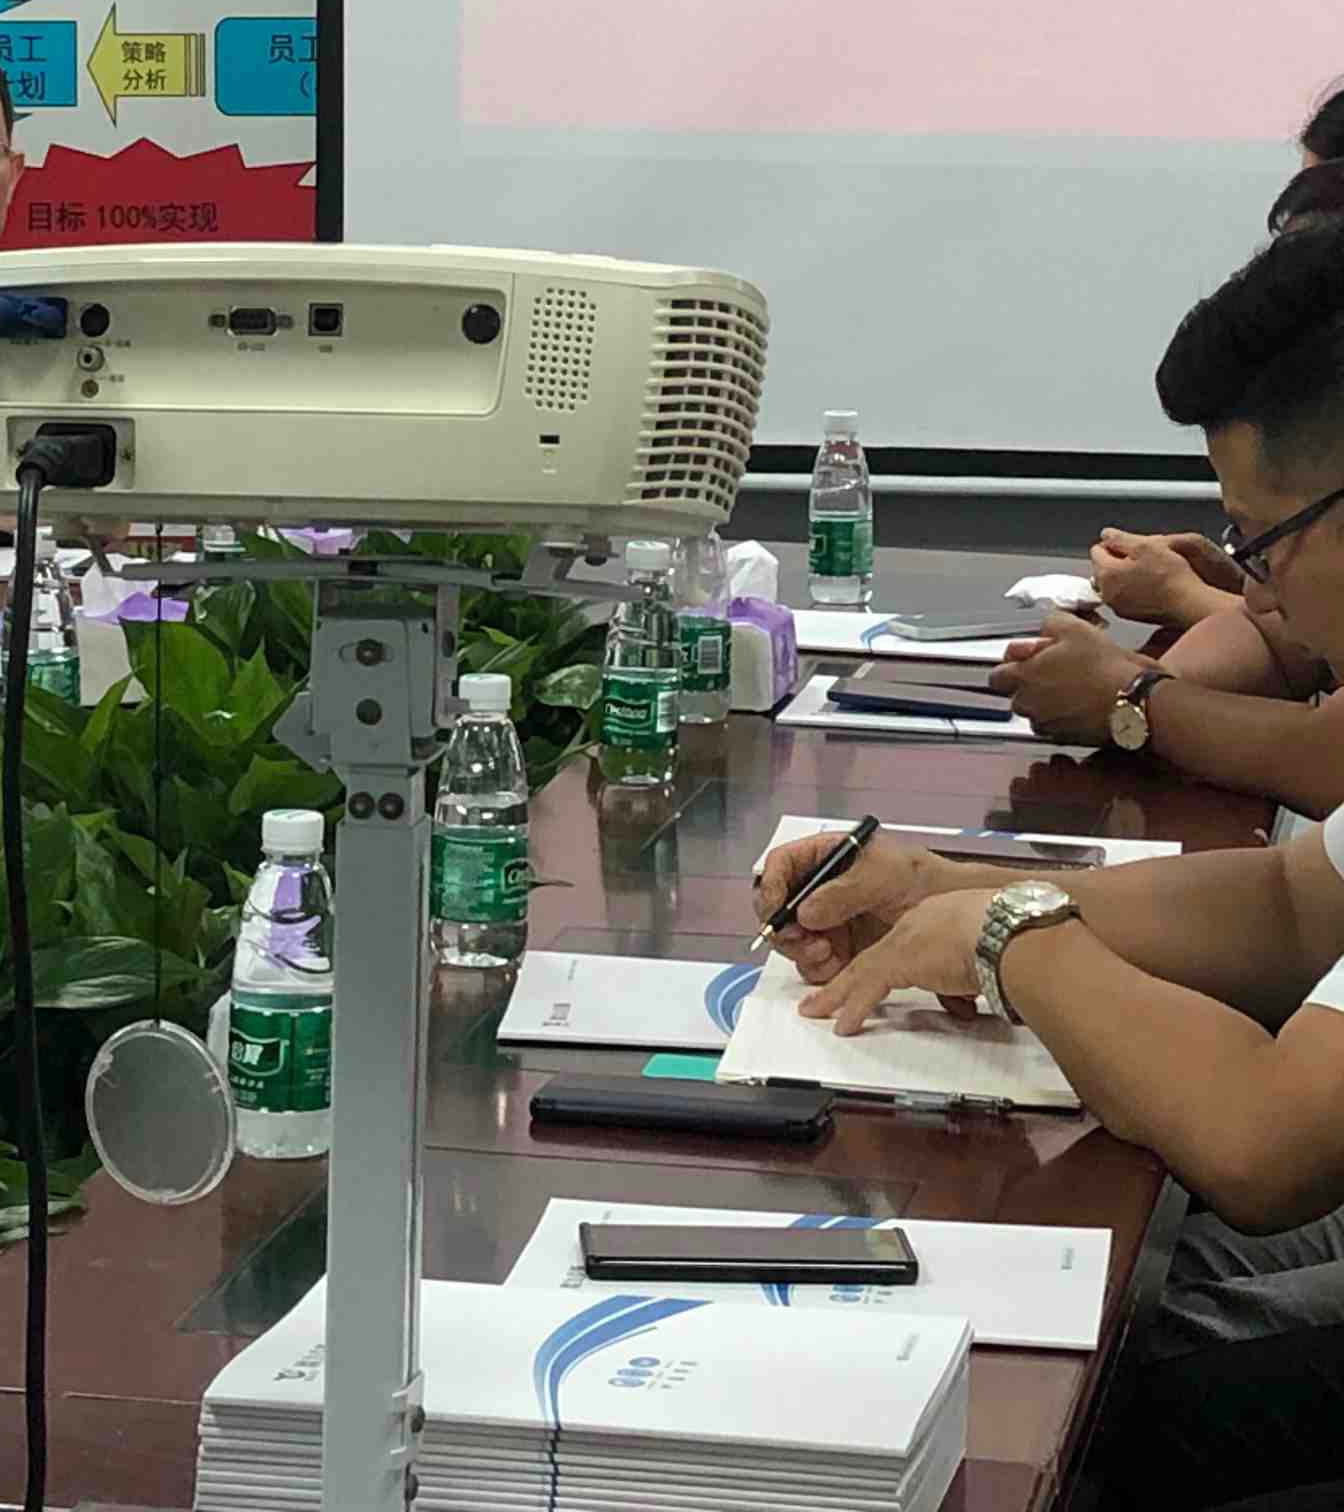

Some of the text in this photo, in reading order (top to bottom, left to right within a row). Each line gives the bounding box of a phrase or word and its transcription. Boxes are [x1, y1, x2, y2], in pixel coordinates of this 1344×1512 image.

[120, 41, 167, 64] 策略
[122, 68, 167, 91] 分析
[27, 202, 219, 232] 目标 100%实现
